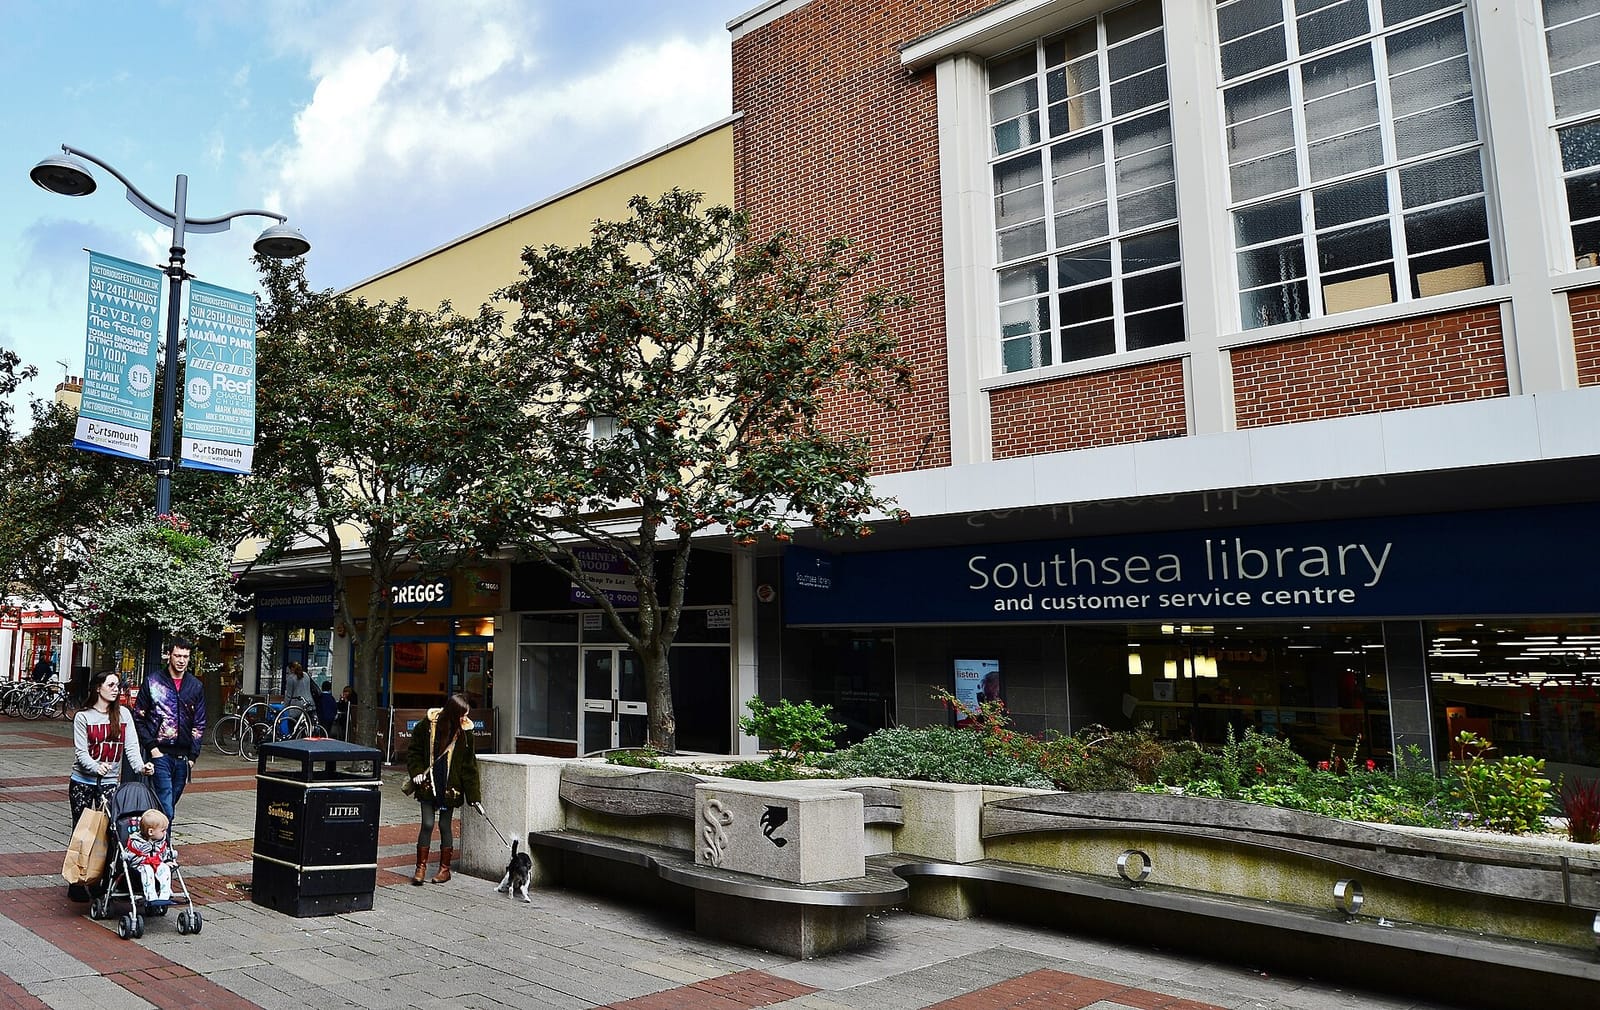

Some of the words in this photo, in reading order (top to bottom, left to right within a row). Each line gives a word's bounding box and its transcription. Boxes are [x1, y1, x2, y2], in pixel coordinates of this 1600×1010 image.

[91, 279, 105, 292] SAT
[107, 283, 127, 297] 24TH
[129, 290, 158, 305] AUGUST
[90, 303, 138, 325] LEVEL
[191, 306, 205, 317] SUN
[206, 309, 225, 323] 25TH
[226, 314, 253, 328] AUGUST
[88, 328, 114, 339] TOTALLY
[89, 315, 110, 328] The
[112, 321, 152, 342] Feeling
[88, 334, 114, 346] EXTINCT
[230, 336, 253, 350] PARK
[88, 343, 98, 356] DJ
[103, 347, 127, 364] YODA
[189, 339, 239, 363] KATY
[244, 349, 253, 366] B
[191, 358, 214, 370] THE
[215, 362, 252, 375] CRIBS
[86, 368, 100, 380] THE
[100, 371, 120, 384] MILK
[132, 371, 148, 384] £15
[213, 373, 253, 395] Reef
[192, 384, 207, 396] £15
[215, 405, 231, 413] MARK
[88, 423, 139, 442] Portsmouth
[192, 442, 242, 458] Portsmouth
[968, 548, 1182, 590] Southsea
[1204, 537, 1393, 587] library
[261, 597, 291, 607] Carphone
[292, 594, 332, 604] Warehouse
[392, 582, 444, 604] GREGGS
[617, 594, 638, 602] 9000
[994, 594, 1033, 611] and
[1040, 591, 1150, 610] customer
[1158, 588, 1251, 608] service
[1261, 585, 1356, 606] centre
[268, 805, 294, 820] Southsea
[329, 807, 359, 816] LITTER
